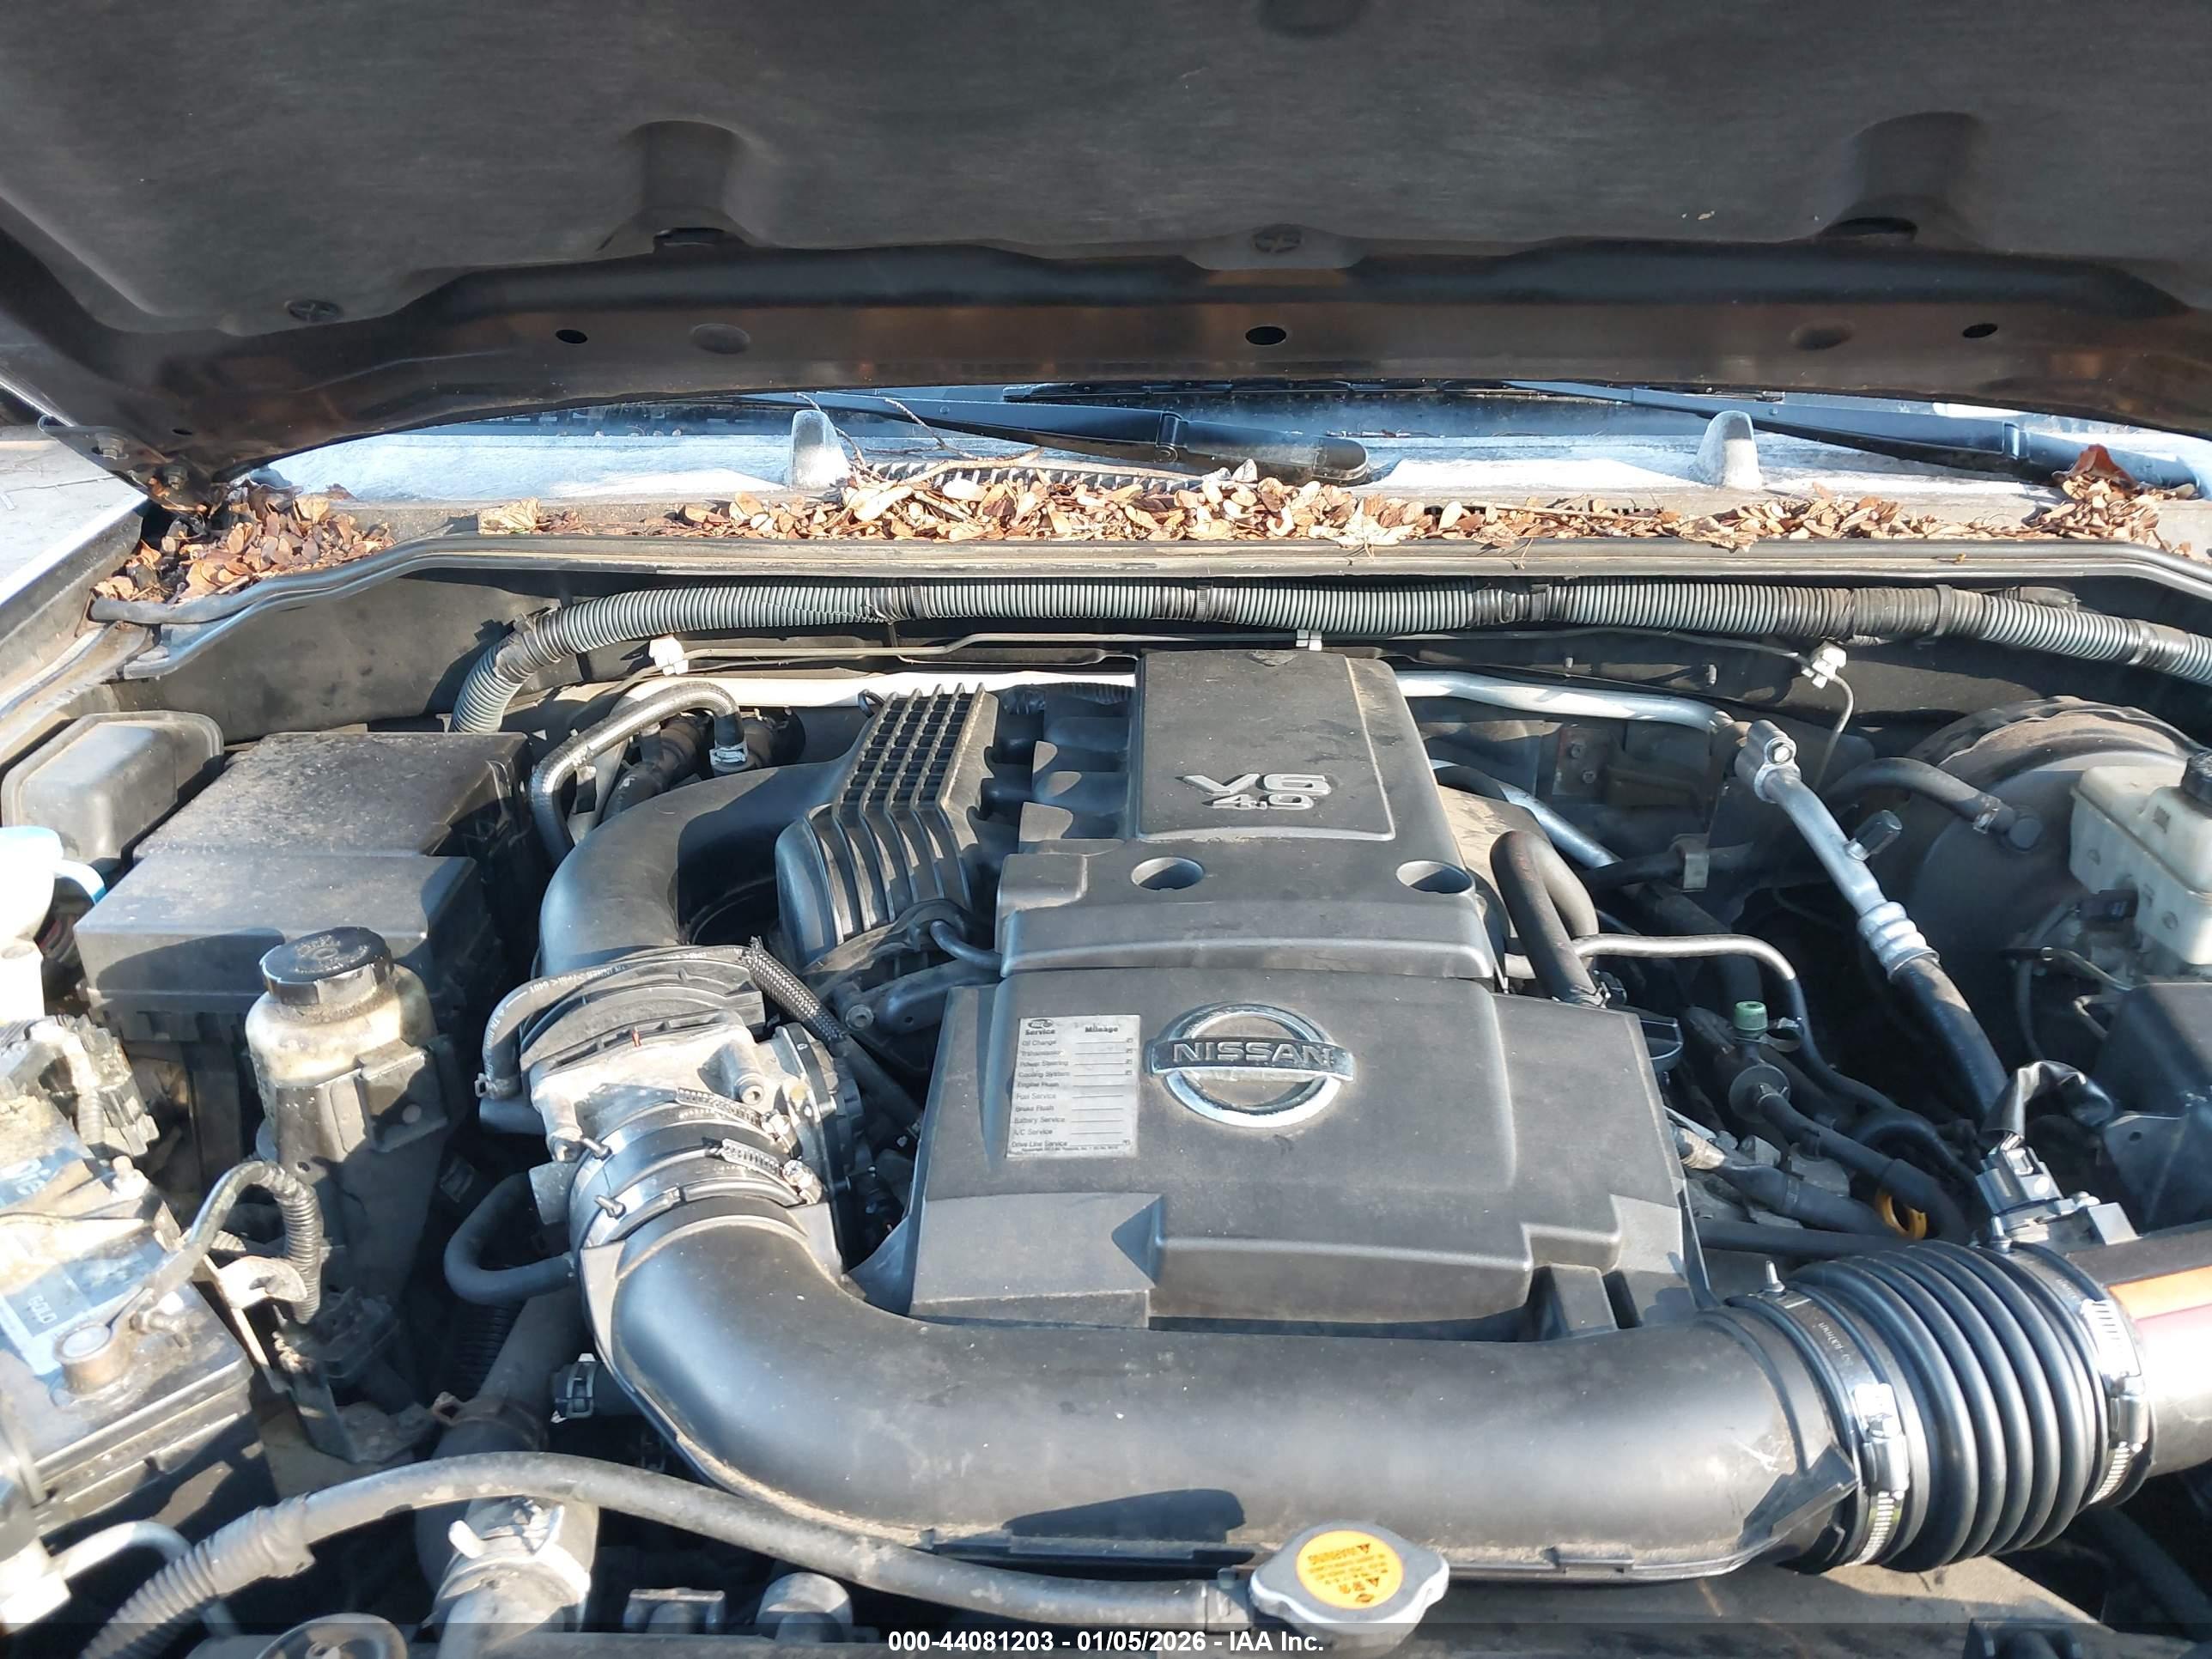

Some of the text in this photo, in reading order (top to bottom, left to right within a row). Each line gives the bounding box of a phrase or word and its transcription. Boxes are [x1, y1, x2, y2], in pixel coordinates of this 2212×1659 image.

[1174, 772, 1332, 796] V6
[1202, 793, 1315, 810] 4.0
[1173, 1041, 1332, 1067] NISSAN
